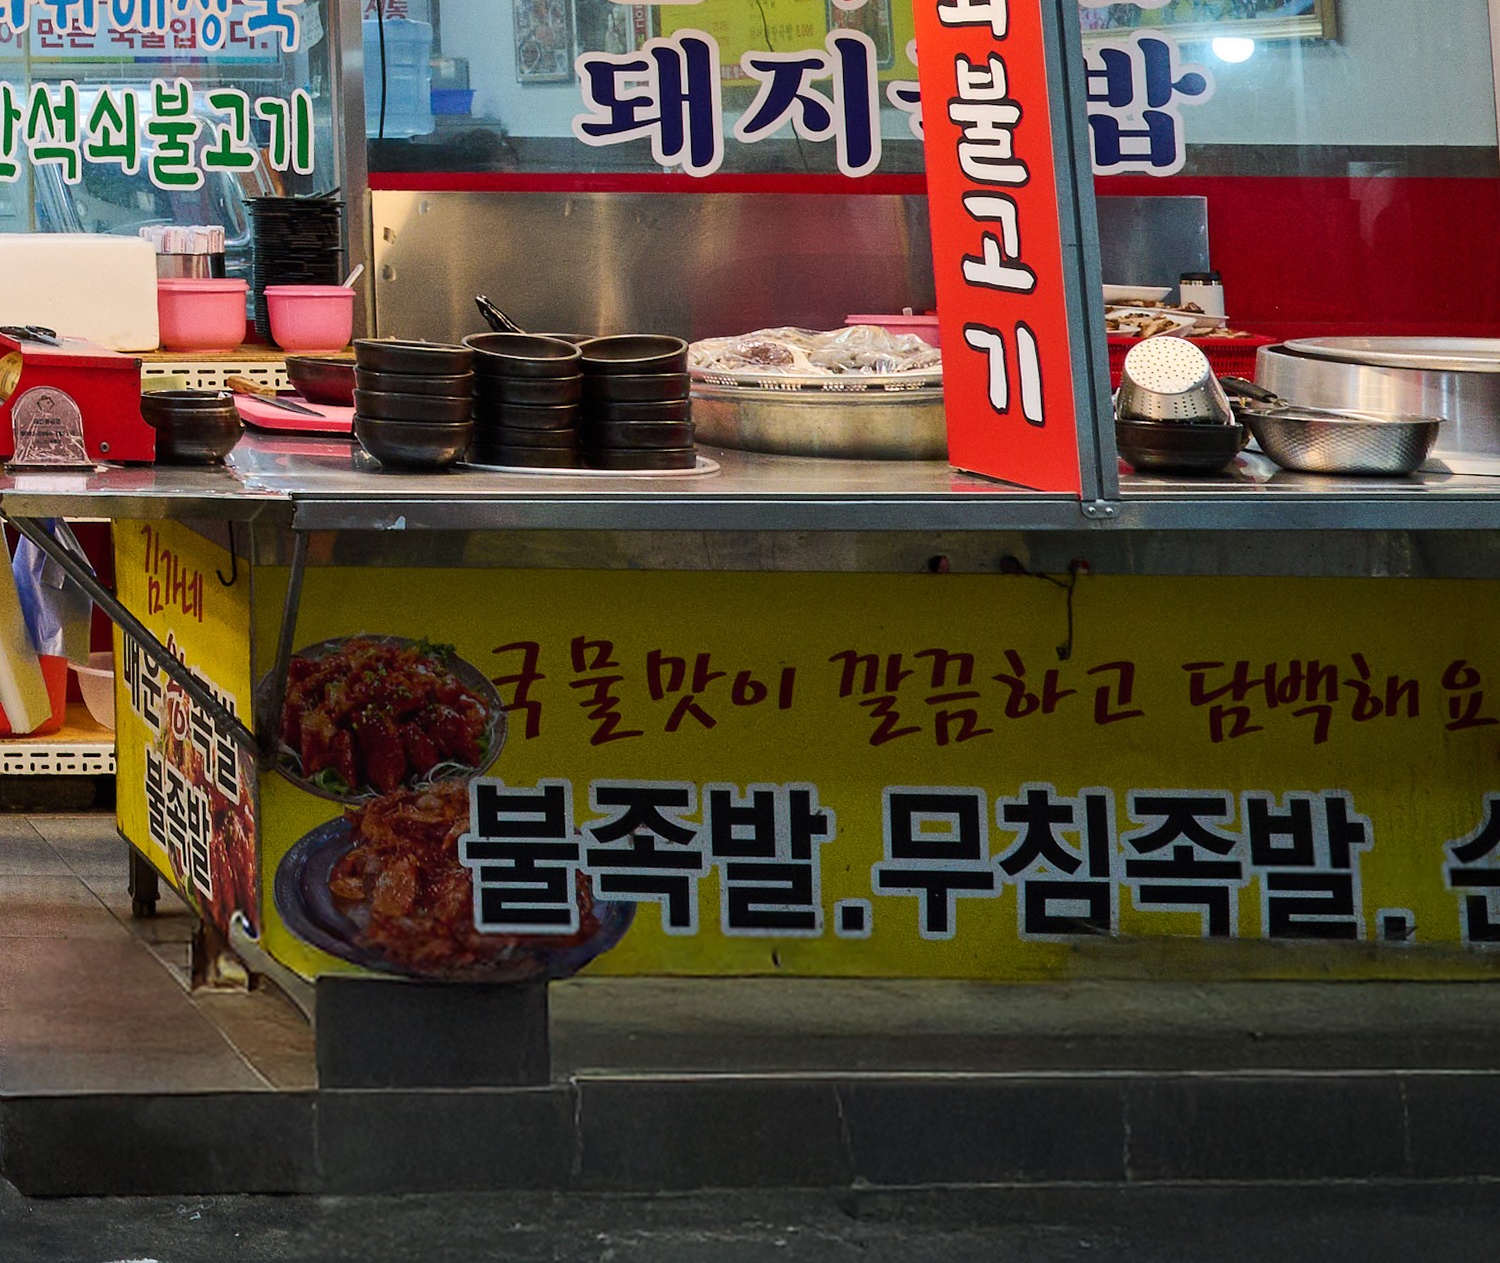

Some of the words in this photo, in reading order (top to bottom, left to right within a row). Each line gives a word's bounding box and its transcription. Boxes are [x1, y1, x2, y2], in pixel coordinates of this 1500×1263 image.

[583, 35, 1208, 172] 돼지밥
[141, 524, 203, 623] 김가네
[491, 636, 797, 747] 국물맛이
[829, 648, 1145, 747] 깔끔하고
[1184, 656, 1498, 745] 담백해요
[145, 748, 211, 895] 불족발
